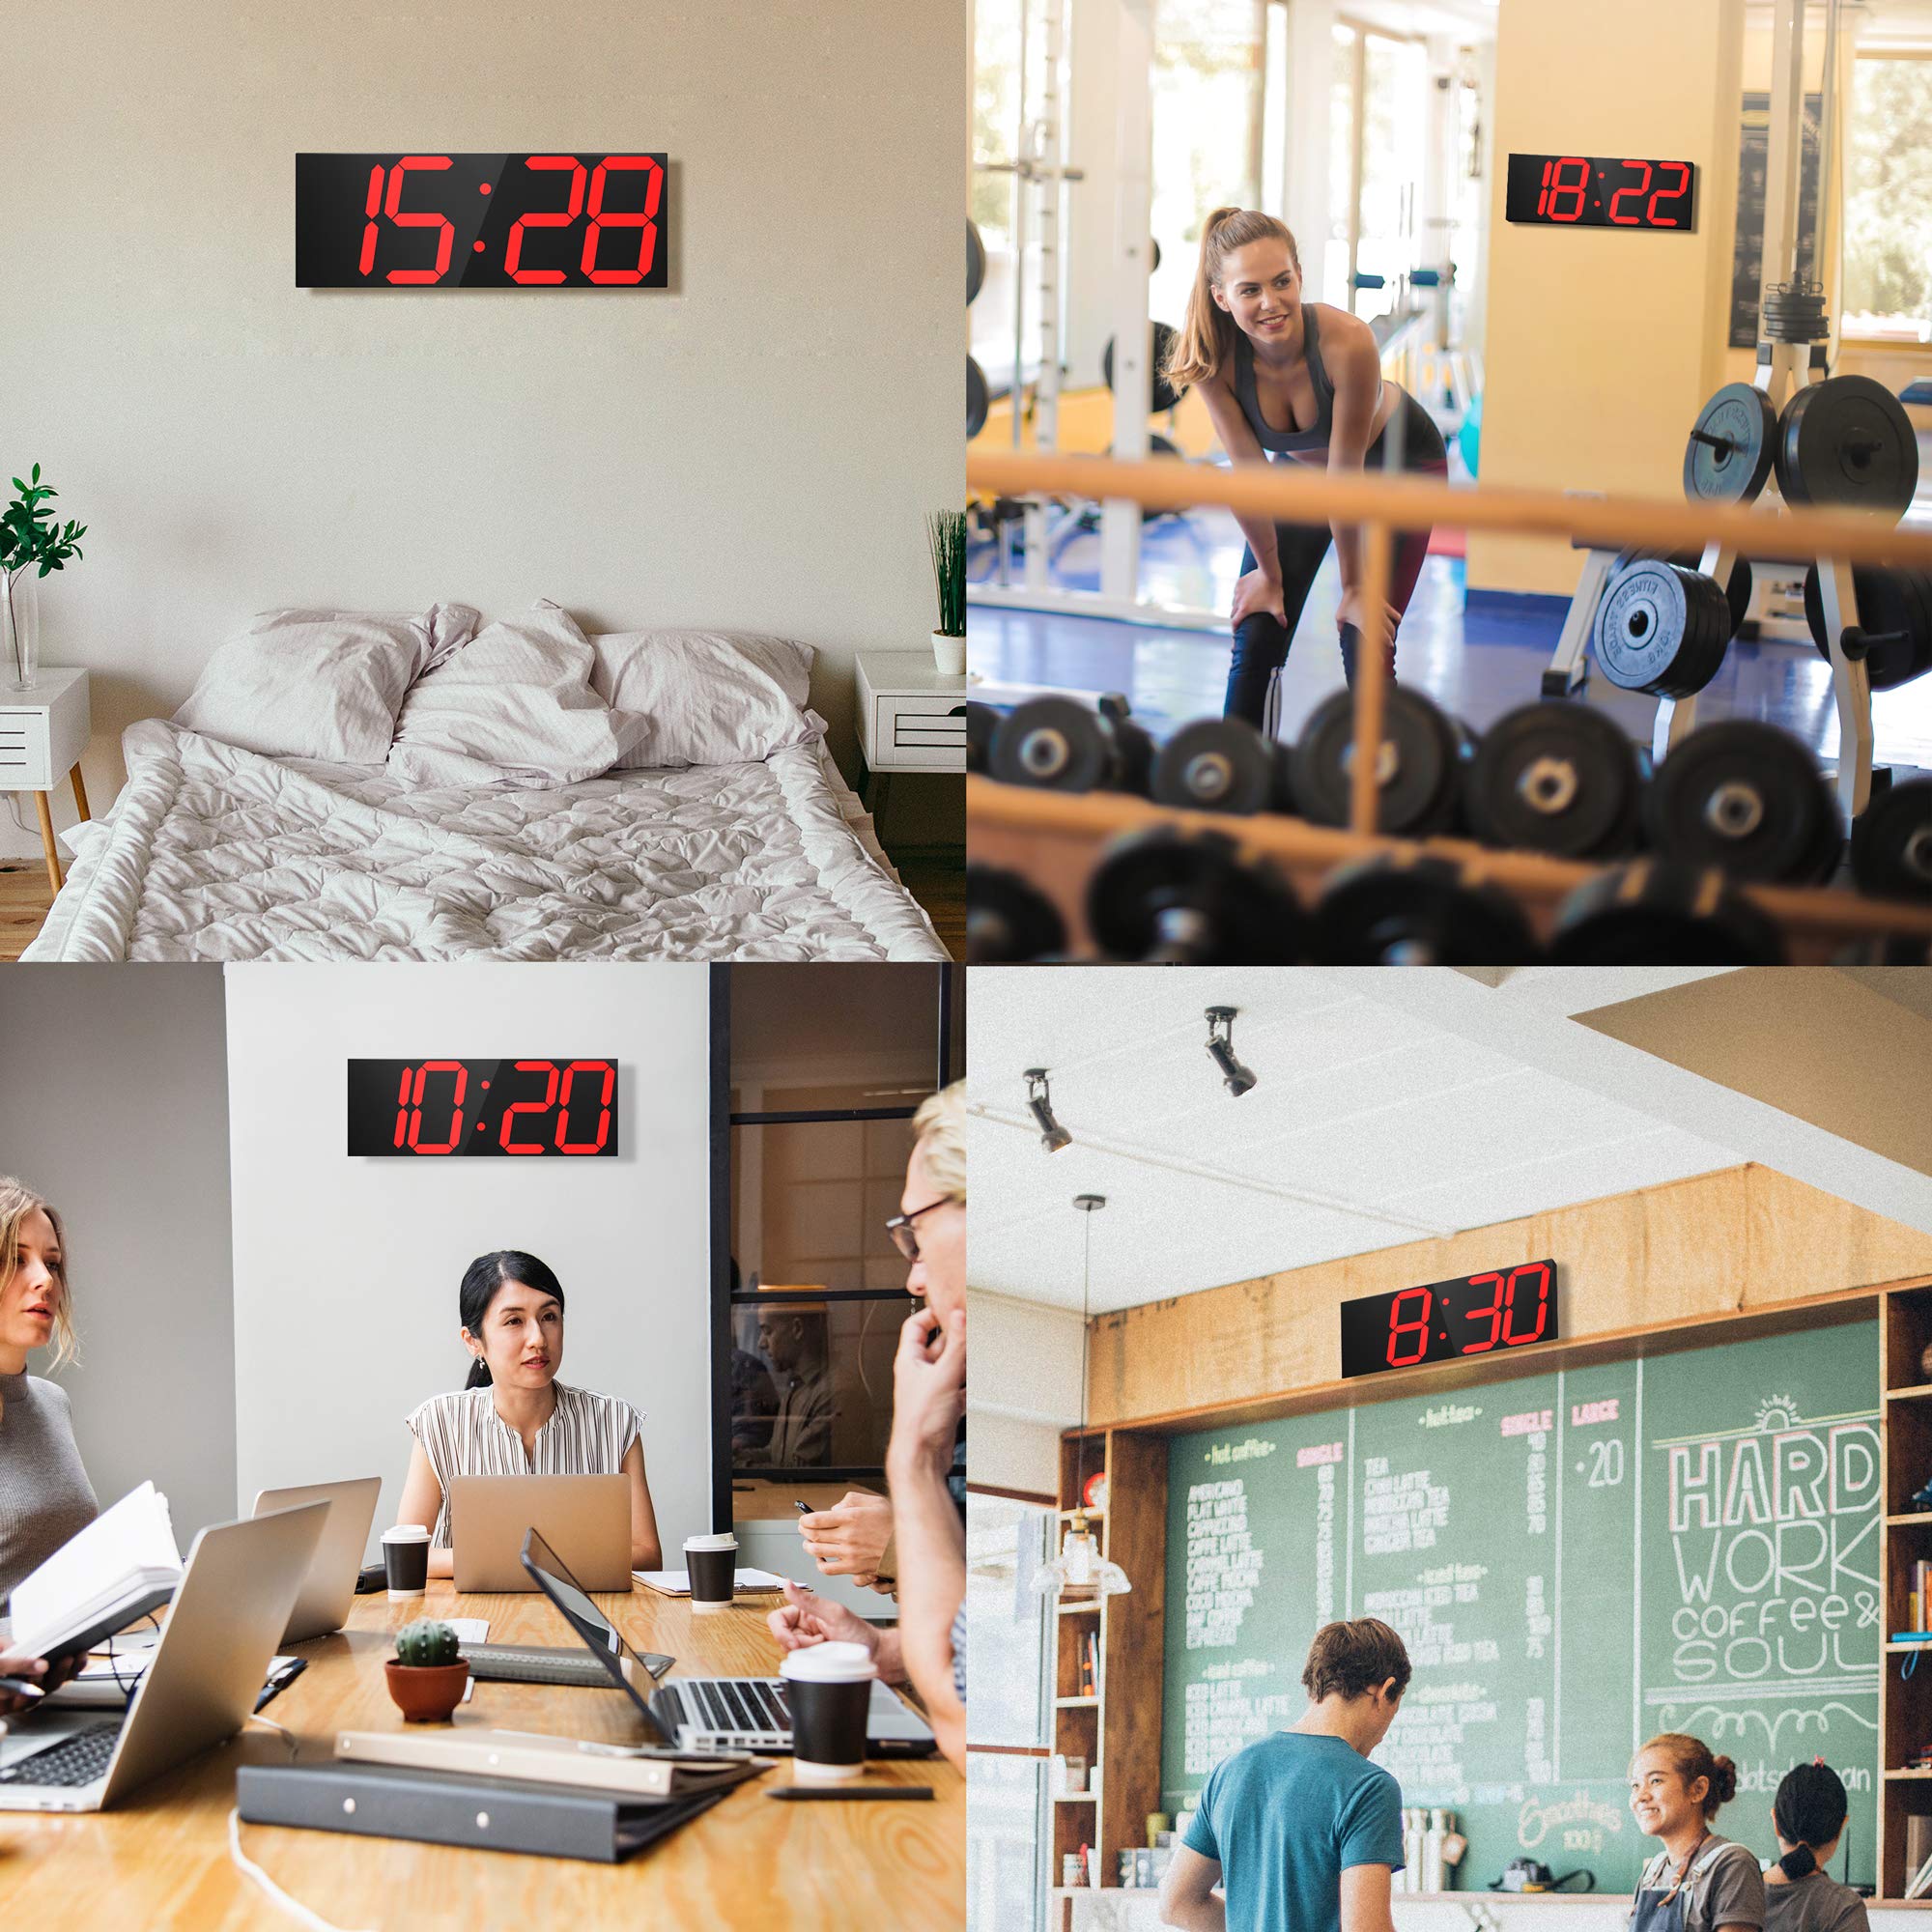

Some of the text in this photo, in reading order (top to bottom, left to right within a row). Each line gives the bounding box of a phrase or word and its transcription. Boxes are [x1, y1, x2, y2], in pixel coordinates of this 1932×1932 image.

[359, 156, 663, 283] 15:28
[1538, 158, 1689, 225] 18:22
[394, 1062, 614, 1153] 10:20
[1387, 1264, 1549, 1366] 8:30
[1669, 1423, 1881, 1531] HARD
[1672, 1514, 1880, 1604] WORK
[1673, 1632, 1880, 1681] SOUL
